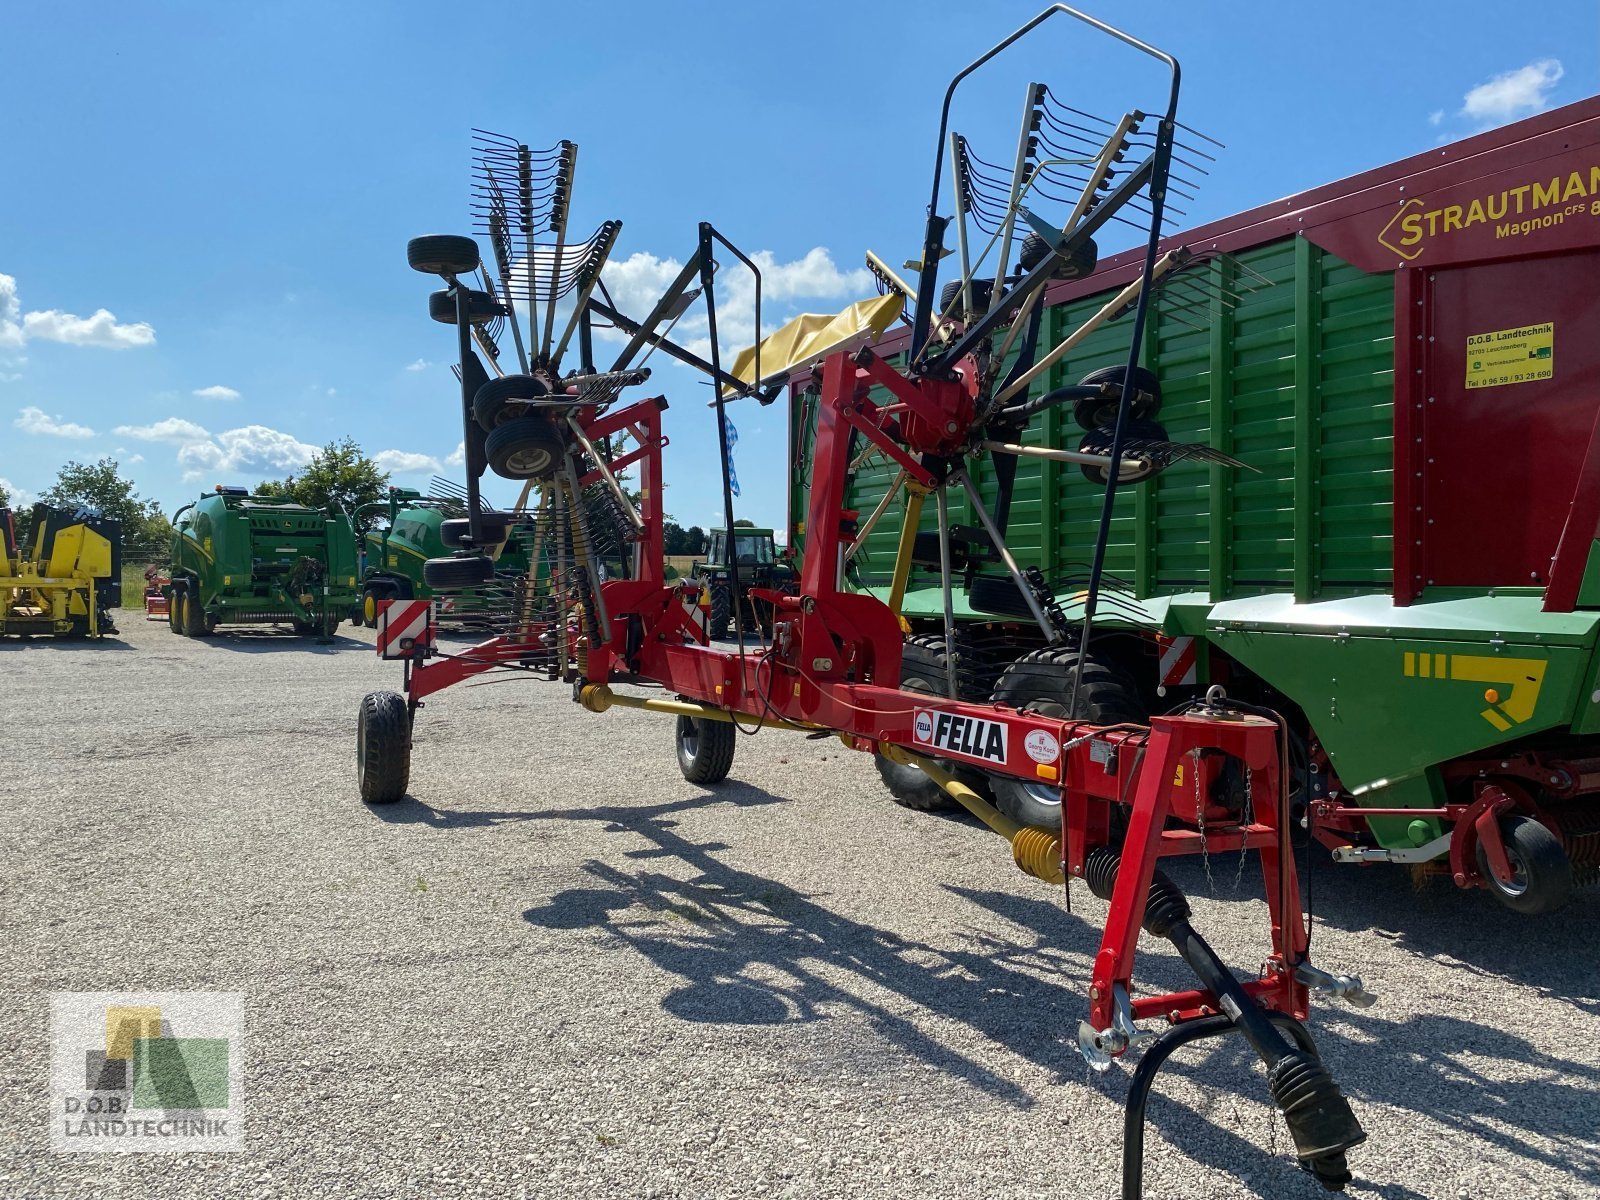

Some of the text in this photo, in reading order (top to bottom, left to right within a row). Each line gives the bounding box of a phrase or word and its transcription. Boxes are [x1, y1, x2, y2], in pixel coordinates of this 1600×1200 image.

[1468, 325, 1552, 346] D.O.B. Landtechnik
[1486, 342, 1527, 353] Leuchtenberg
[1489, 377, 1498, 385] 96
[1526, 372, 1535, 380] 28
[1537, 370, 1552, 378] 690
[917, 721, 931, 732] FELLA
[934, 713, 1005, 762] FELLA
[1028, 742, 1042, 752] Georg
[1043, 746, 1056, 755] Koch
